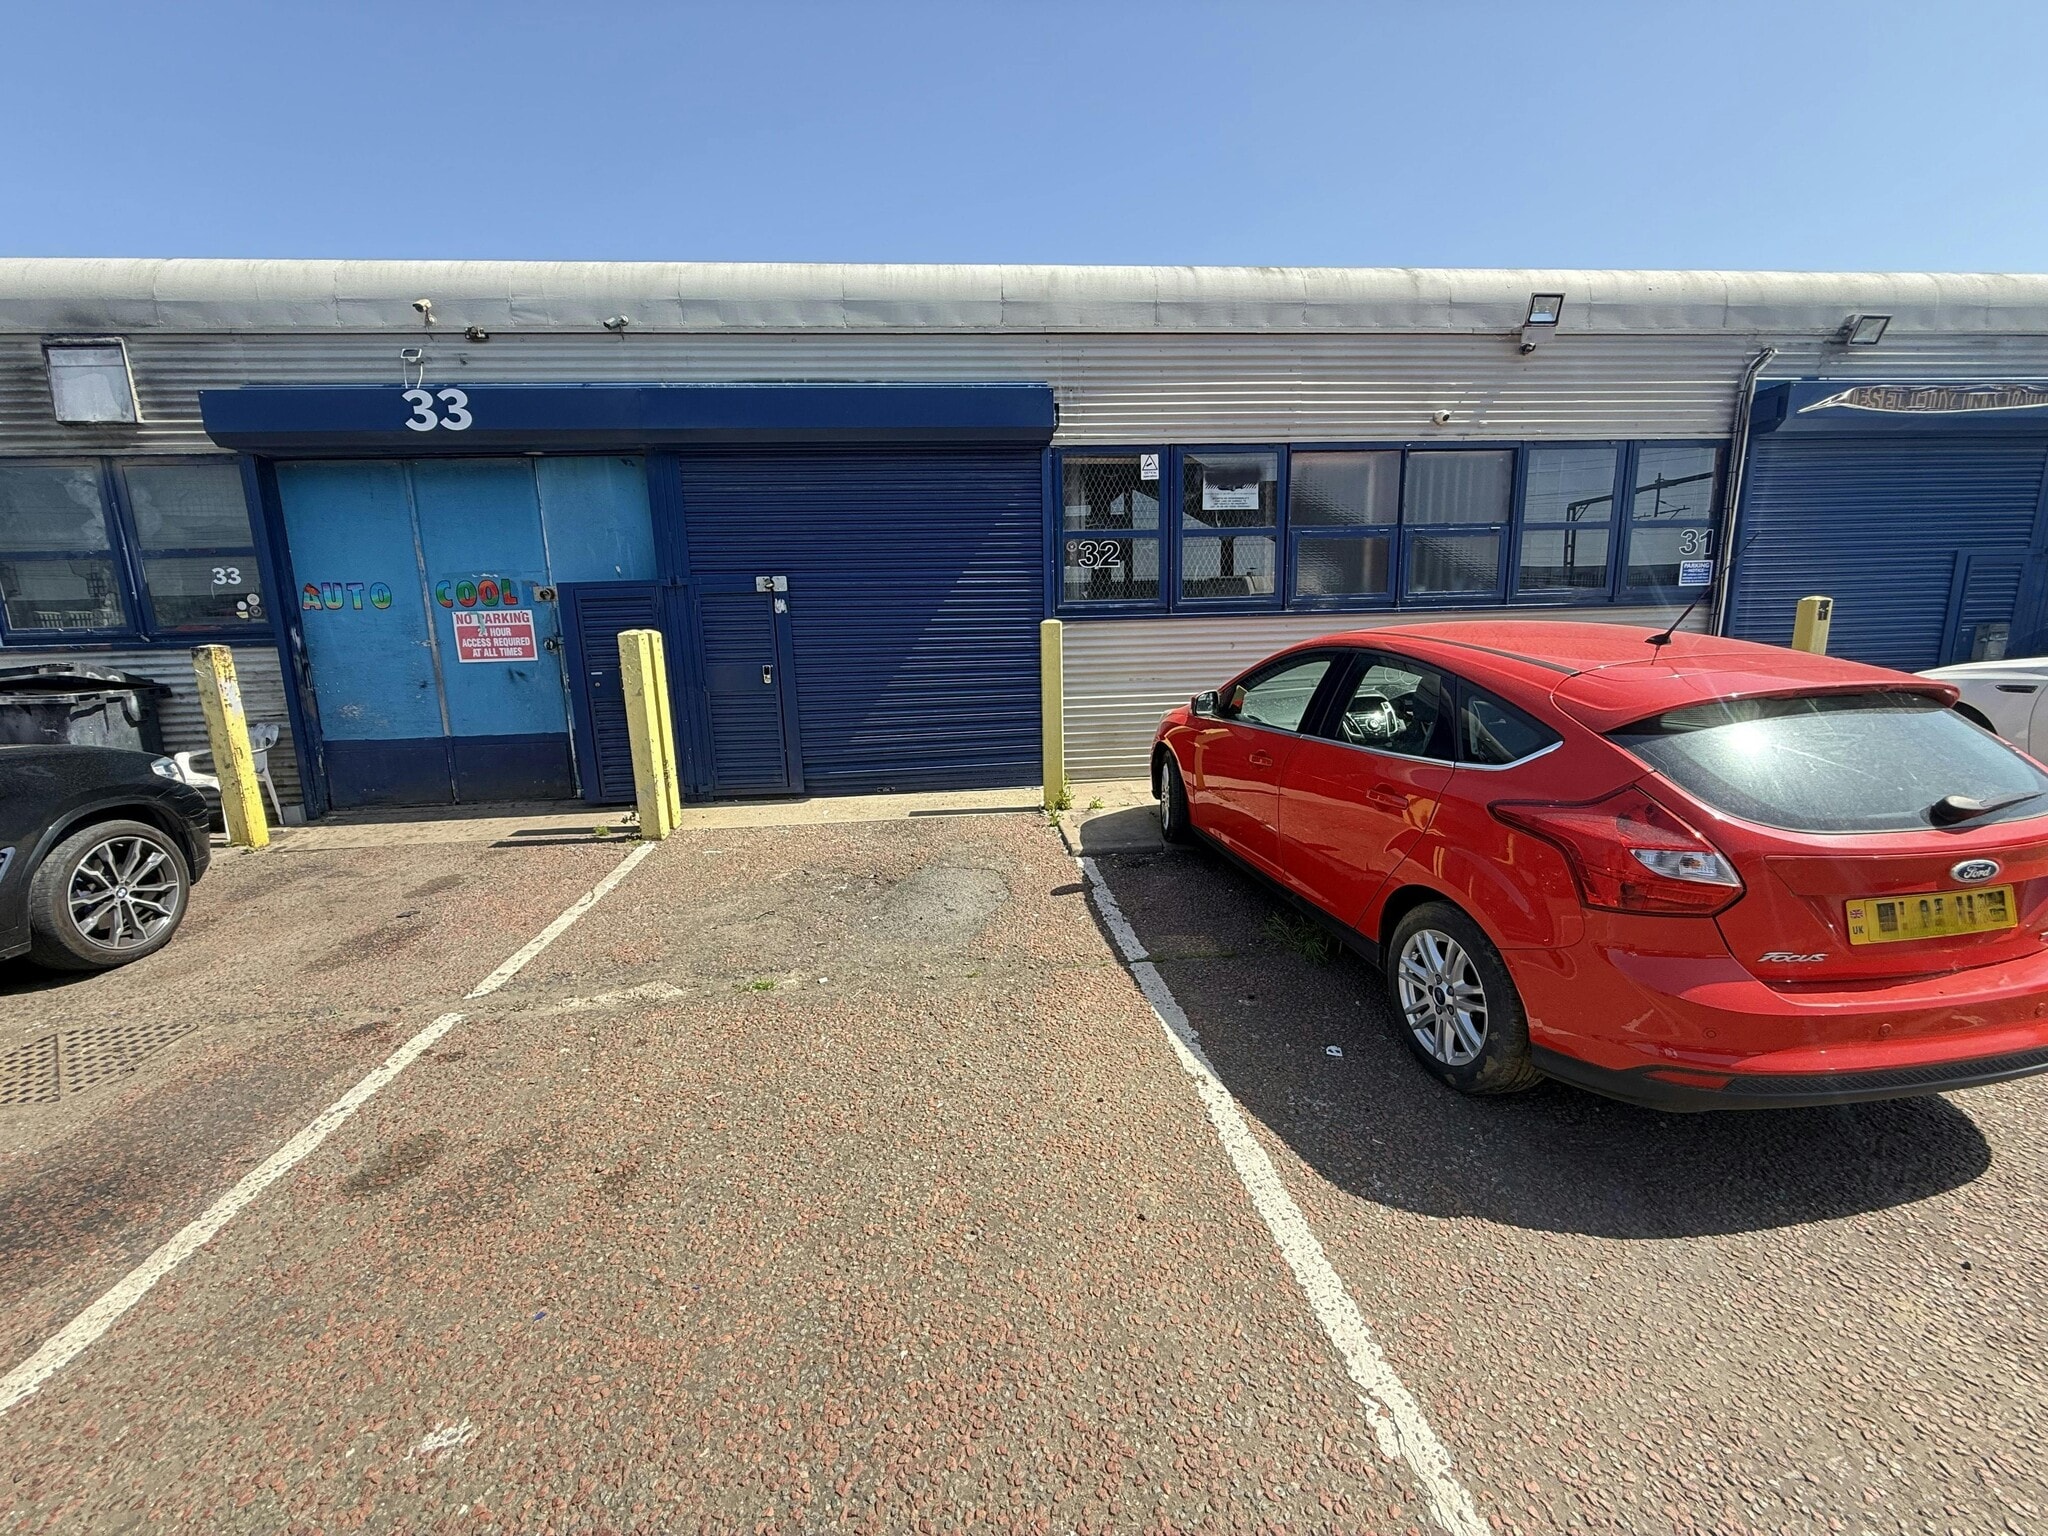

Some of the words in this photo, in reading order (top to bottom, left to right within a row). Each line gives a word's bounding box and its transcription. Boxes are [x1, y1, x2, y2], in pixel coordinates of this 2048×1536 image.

[402, 388, 473, 431] 33
[1679, 529, 1714, 555] 31
[1078, 540, 1120, 568] 32
[211, 567, 242, 585] 33
[302, 581, 393, 611] AUTO
[435, 578, 519, 608] COOL
[455, 613, 472, 625] NO
[489, 627, 512, 637] HOUR
[462, 637, 492, 648] ACCESS
[493, 636, 531, 647] REQUIRED
[472, 648, 482, 657] AT
[483, 647, 498, 657] ALL
[498, 647, 523, 657] TIMES
[1963, 863, 1991, 879] Ford
[1852, 926, 1865, 935] UK
